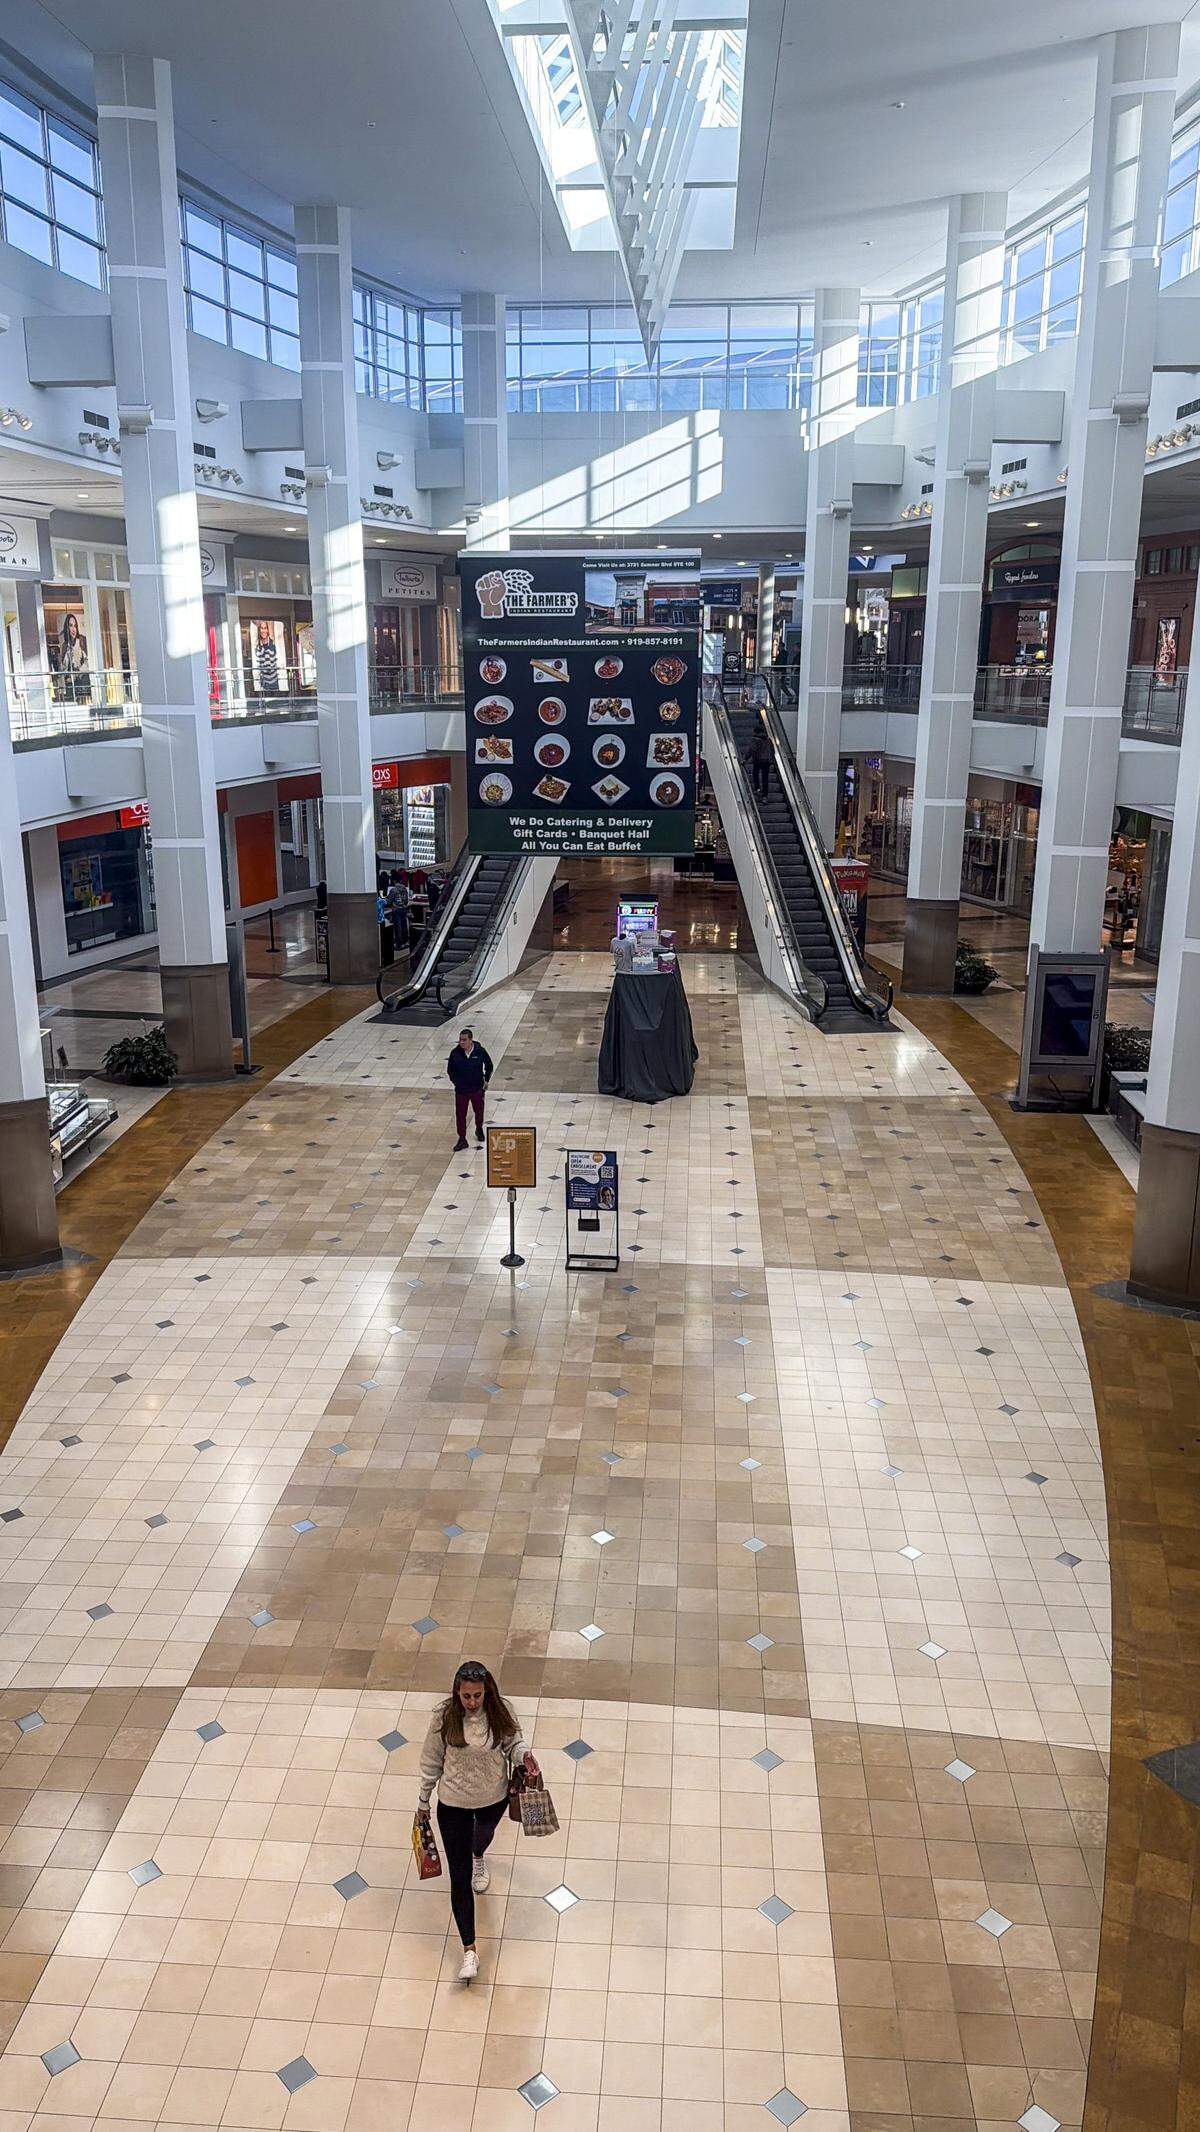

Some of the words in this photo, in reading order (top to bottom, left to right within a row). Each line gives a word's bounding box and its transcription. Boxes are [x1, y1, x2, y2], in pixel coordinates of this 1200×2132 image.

[388, 588, 431, 596] PETITES
[505, 594, 525, 608] THE
[527, 594, 577, 608] FARMER'S
[477, 638, 619, 646] TheFarmersIndianRestaurant.com
[627, 637, 684, 646] 919-857-8191
[509, 817, 526, 826] We
[529, 817, 544, 826] Do
[546, 817, 593, 828] Catering
[596, 817, 605, 826] &
[608, 817, 654, 828] Delivery
[513, 829, 533, 838] Gift
[536, 829, 568, 838] Cards
[579, 829, 625, 840] Banquet
[627, 829, 650, 839] Hall
[521, 841, 536, 850] All
[539, 841, 559, 850] You
[562, 841, 583, 850] Can
[586, 841, 605, 850] Eat
[608, 841, 642, 851] Buffet
